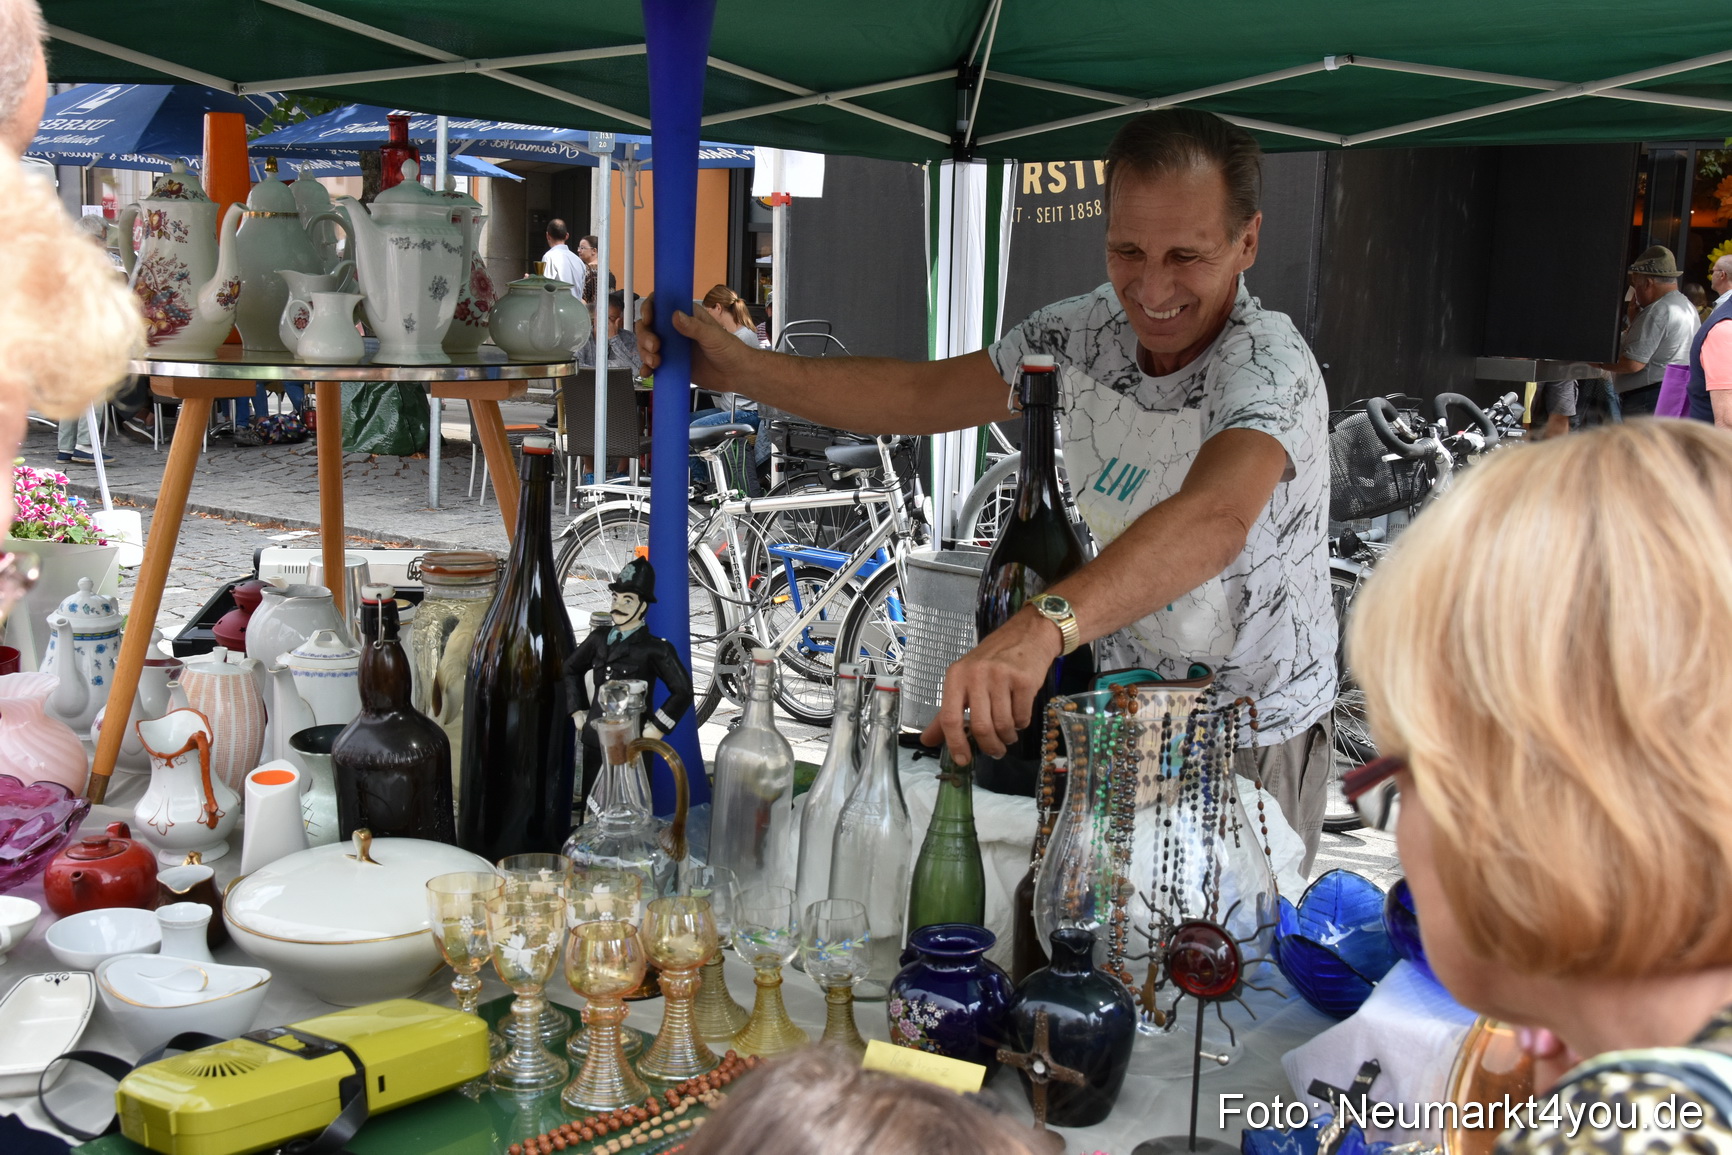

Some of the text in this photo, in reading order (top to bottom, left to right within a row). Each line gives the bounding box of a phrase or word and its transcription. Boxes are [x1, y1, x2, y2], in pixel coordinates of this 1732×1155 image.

[1036, 206, 1064, 224] SEIT
[1070, 199, 1102, 220] 1858
[1093, 457, 1149, 504] LIV
